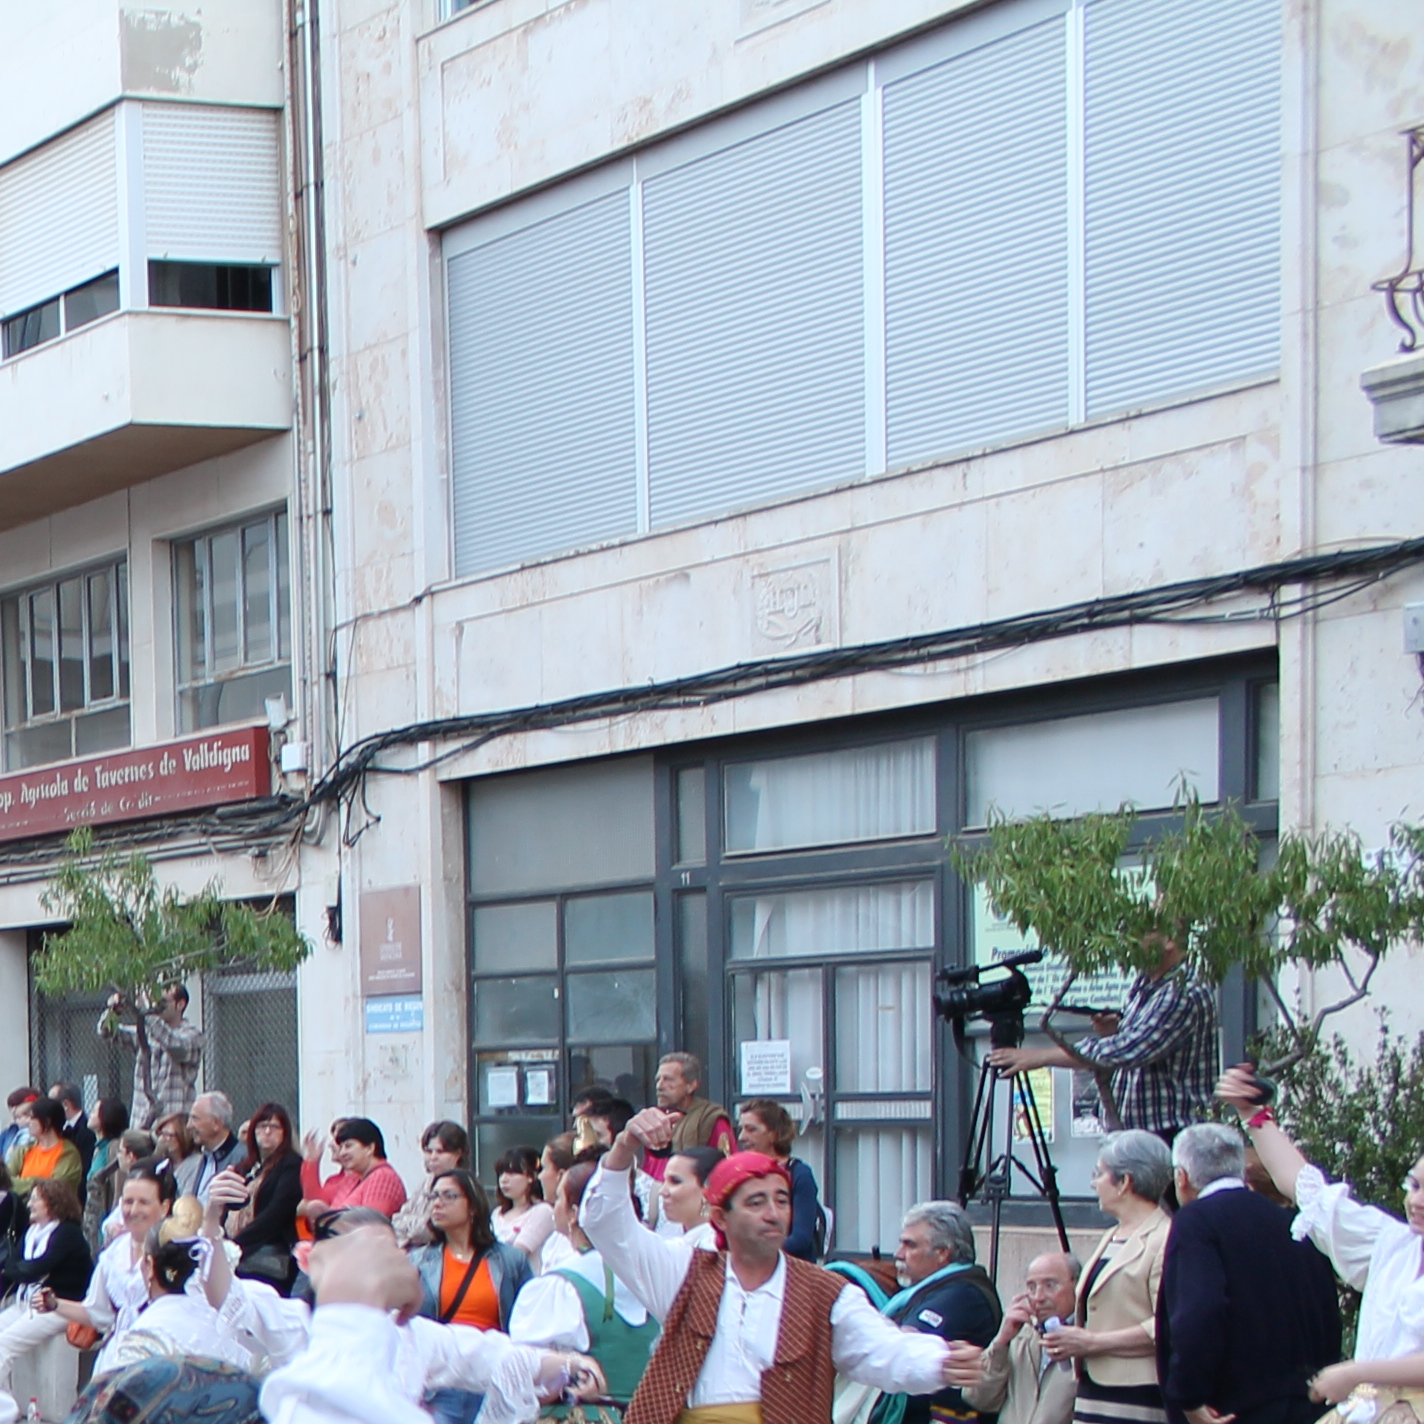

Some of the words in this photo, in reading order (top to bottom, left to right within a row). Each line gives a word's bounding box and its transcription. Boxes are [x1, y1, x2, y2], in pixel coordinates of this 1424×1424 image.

[74, 768, 90, 793] de
[95, 761, 155, 789] Tavernes
[159, 751, 177, 776] de
[183, 740, 250, 773] Valldigna
[119, 791, 152, 813] Crdit
[681, 871, 690, 886] 11
